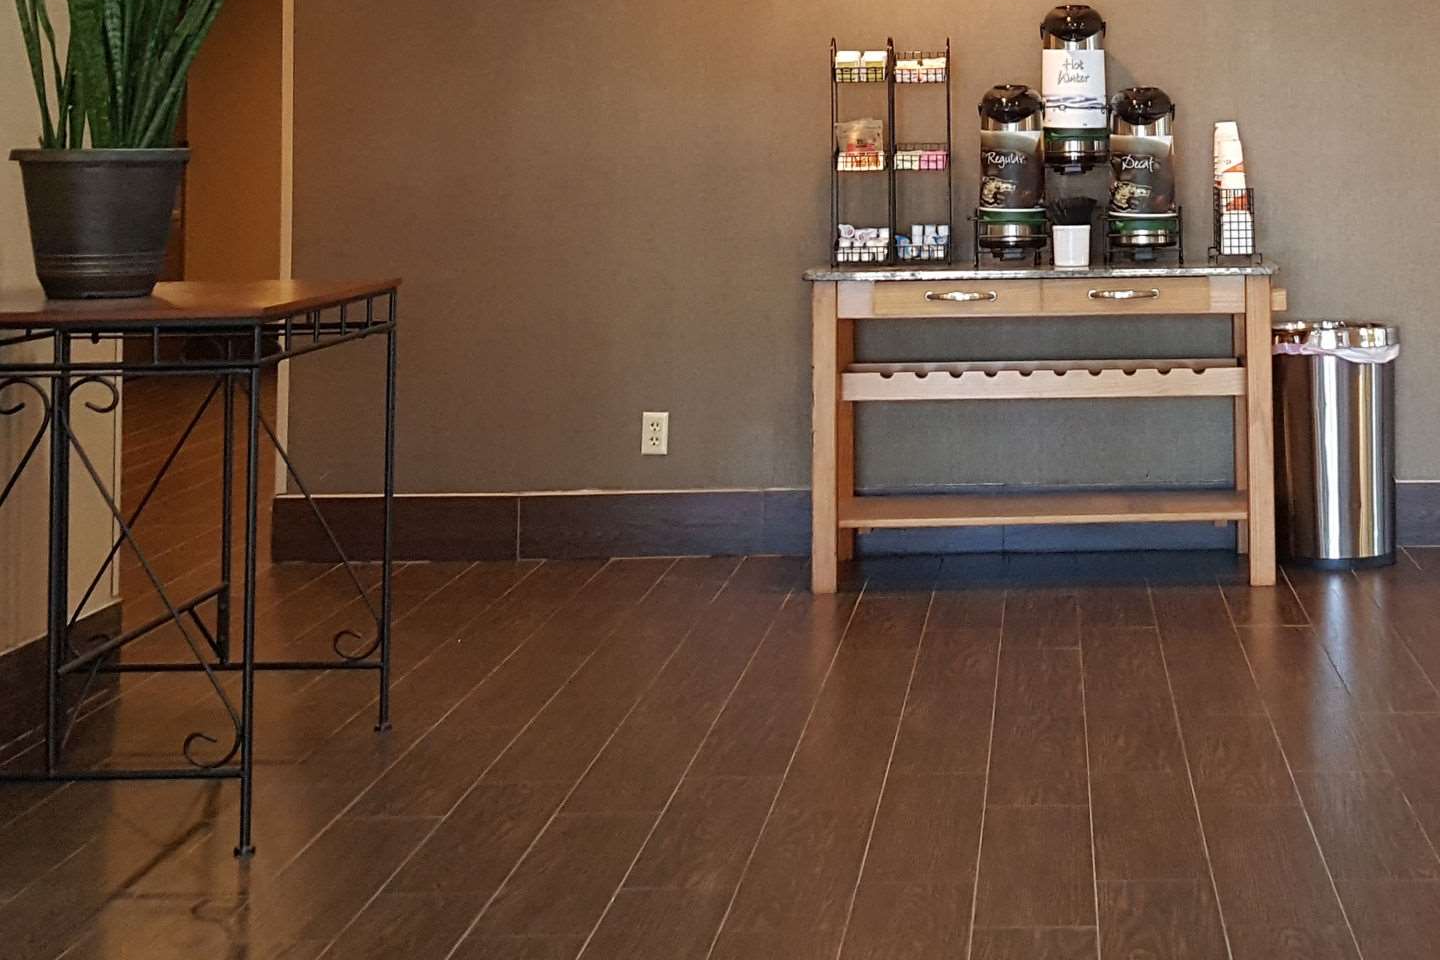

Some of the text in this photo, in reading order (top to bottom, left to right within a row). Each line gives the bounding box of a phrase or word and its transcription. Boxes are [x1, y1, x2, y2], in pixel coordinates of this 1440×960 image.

[1062, 58, 1085, 72] Hot
[1057, 70, 1090, 85] Water
[985, 151, 1025, 169] Regular
[1121, 153, 1155, 173] Decaf
